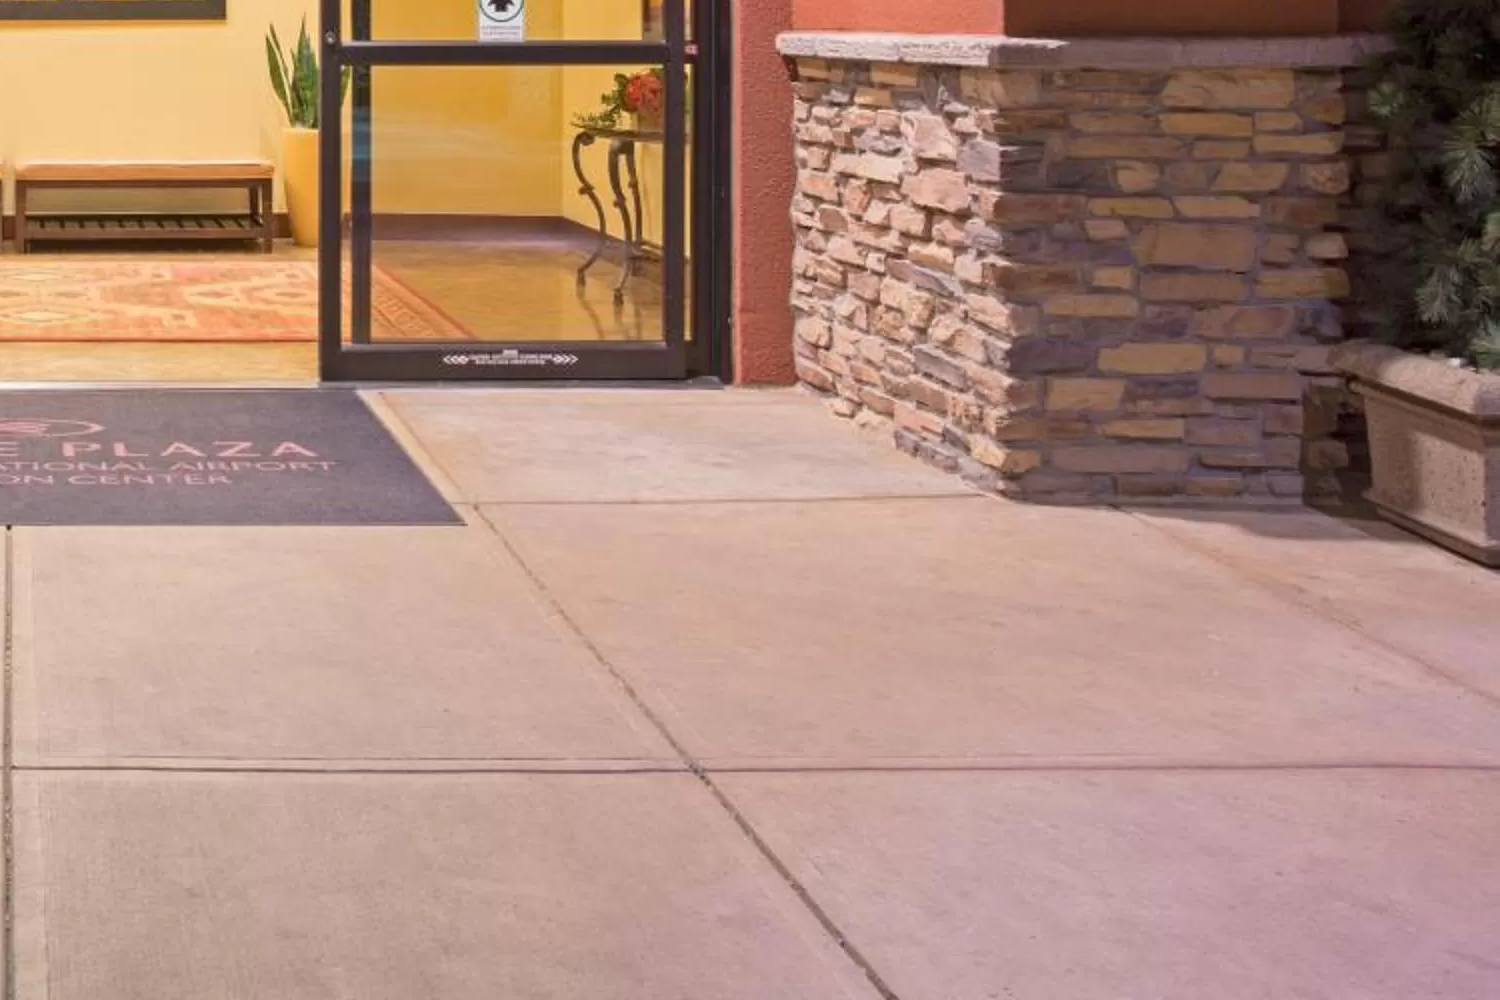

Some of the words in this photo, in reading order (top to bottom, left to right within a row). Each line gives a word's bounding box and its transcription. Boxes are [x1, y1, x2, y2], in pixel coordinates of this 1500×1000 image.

[61, 441, 319, 457] PLAZA
[168, 460, 337, 472] AIRPORT
[67, 474, 233, 485] CENTER
